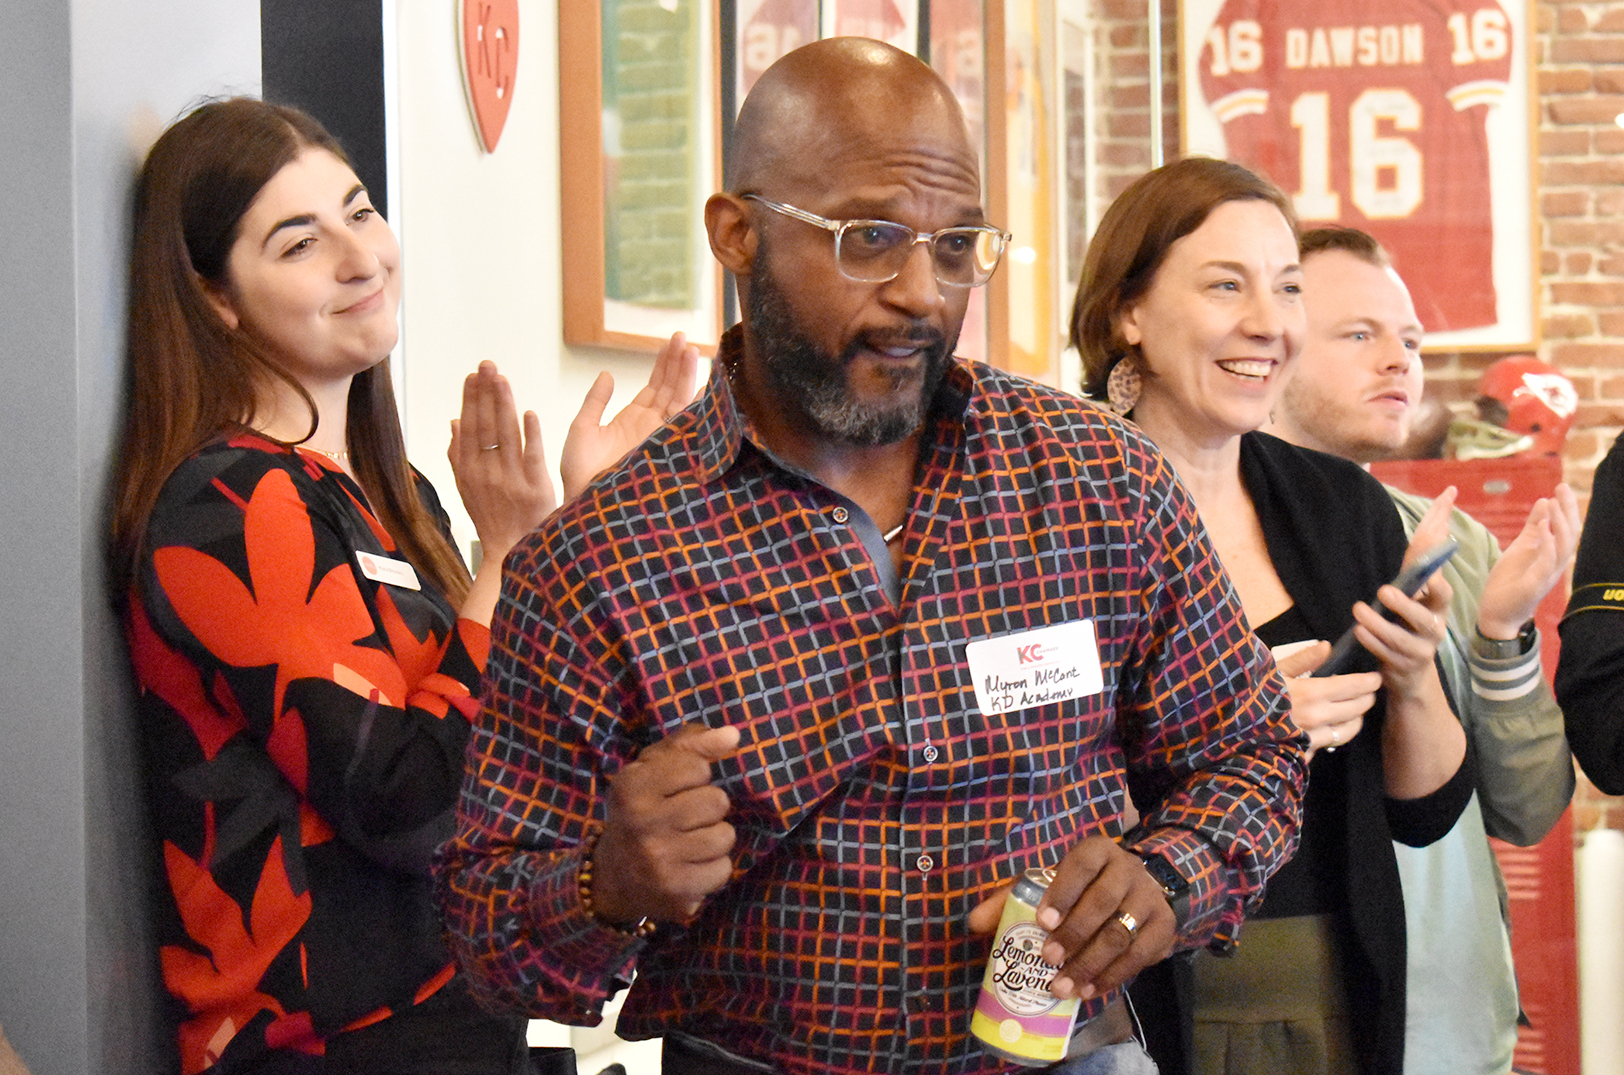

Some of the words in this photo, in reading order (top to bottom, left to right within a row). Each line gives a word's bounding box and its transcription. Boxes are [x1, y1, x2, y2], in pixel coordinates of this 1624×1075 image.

[1209, 20, 1263, 76] 16
[1286, 24, 1424, 69] DAWSON
[1448, 8, 1508, 65] 16
[1291, 88, 1424, 220] 16
[1017, 643, 1044, 664] KC
[992, 935, 1065, 970] Lemon
[1023, 966, 1048, 977] AND
[993, 960, 1052, 992] Laven
